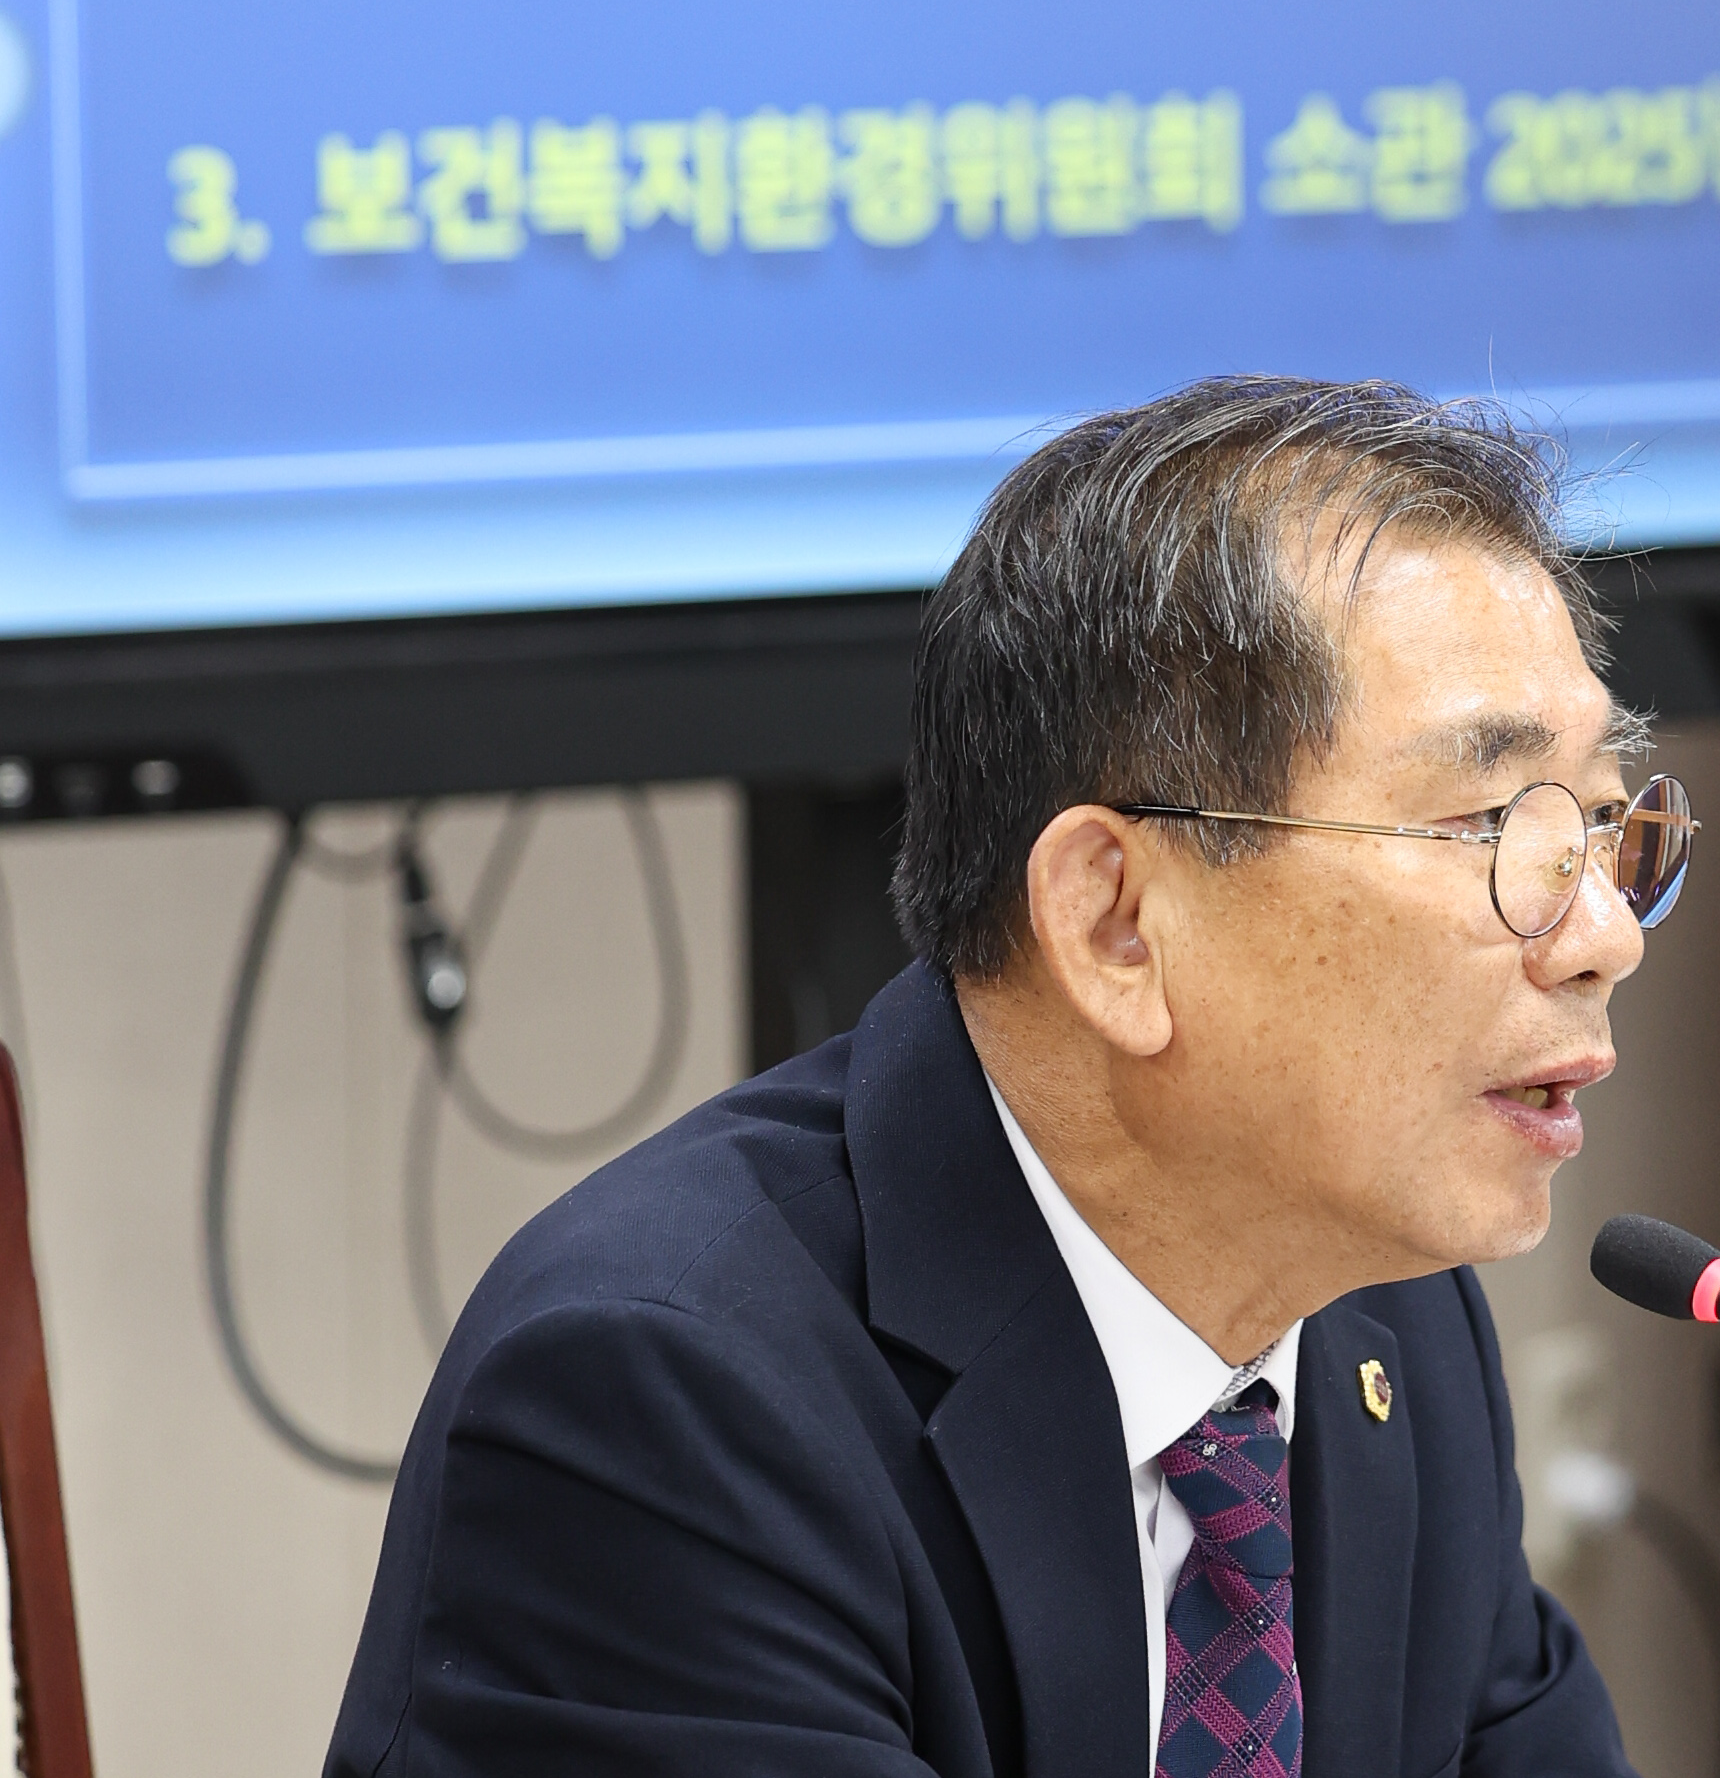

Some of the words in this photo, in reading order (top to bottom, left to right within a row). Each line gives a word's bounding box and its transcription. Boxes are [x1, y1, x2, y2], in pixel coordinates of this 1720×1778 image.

[168, 147, 268, 264] 3.
[307, 91, 1239, 261] 보건복지환경위원회
[1263, 82, 1468, 220] 소관
